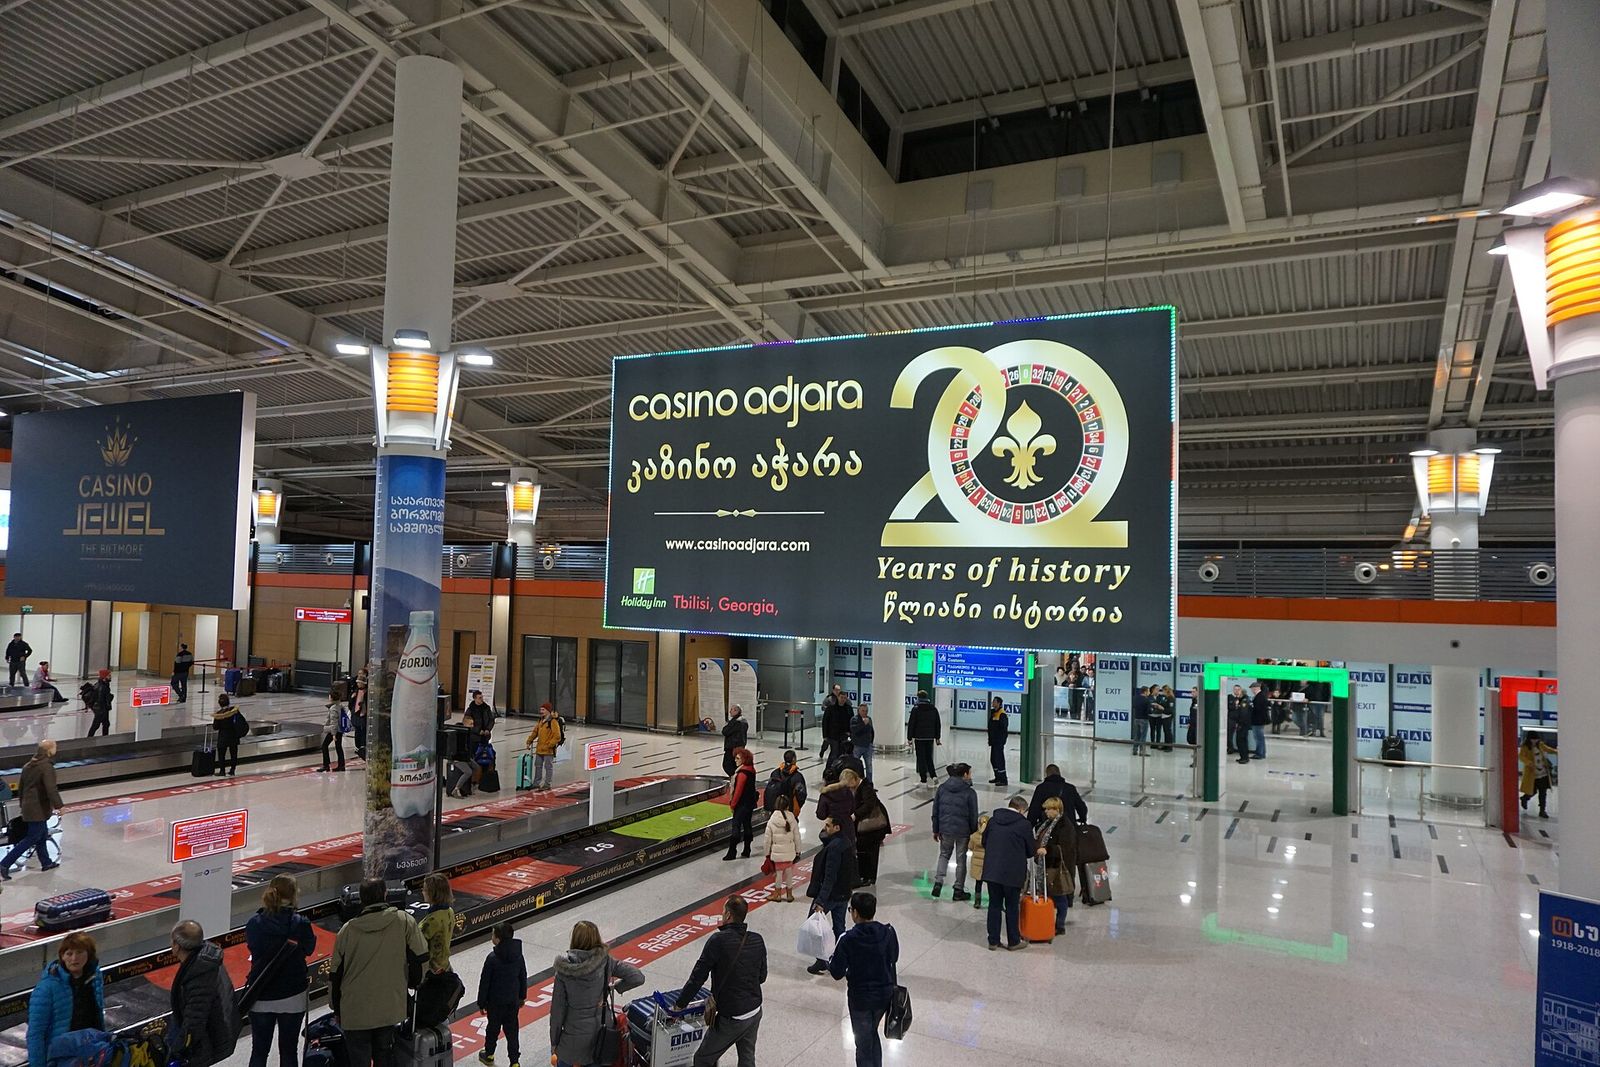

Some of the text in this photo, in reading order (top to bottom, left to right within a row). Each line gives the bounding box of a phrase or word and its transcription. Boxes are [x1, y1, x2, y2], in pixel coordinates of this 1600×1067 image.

[1008, 370, 1019, 381] 26
[1023, 368, 1029, 379] 0
[1032, 368, 1043, 380] 32
[1044, 370, 1054, 382] 15
[1064, 381, 1072, 392] 4
[629, 376, 863, 428] casino adjara
[970, 394, 981, 406] 28
[1080, 400, 1090, 408] 2
[1084, 408, 1096, 420] 25
[958, 415, 968, 426] 29
[1088, 422, 1098, 430] 17
[954, 438, 962, 448] 22
[627, 436, 862, 493] კაზინო აჭარა
[1086, 457, 1096, 468] 27
[1080, 469, 1092, 480] 13
[79, 472, 152, 497] CASINO
[964, 482, 976, 494] 20
[1066, 488, 1078, 500] 11
[980, 498, 992, 509] 33
[1048, 502, 1056, 513] 8
[1056, 496, 1068, 508] 30
[990, 503, 1000, 514] 16
[1036, 506, 1047, 518] 23
[63, 502, 165, 536] JEWEL
[1024, 510, 1034, 520] 10
[81, 544, 98, 554] THE
[665, 538, 810, 554] www.casinoadjara.com
[878, 556, 1131, 590] Years of history
[621, 596, 666, 609] Holiday Inn
[673, 594, 779, 616] Tbilisi, Georgia,
[883, 590, 1123, 629] წლიანი ისტორია
[1099, 660, 1130, 670] TAV
[1140, 661, 1172, 672] TAV
[1180, 663, 1204, 673] TA
[1350, 672, 1386, 682] TAV
[960, 700, 986, 710] TAV
[1098, 710, 1129, 721] TAV
[584, 842, 614, 854] 26
[570, 859, 635, 888] www.casinoiveria.com
[648, 926, 704, 952] MAGTI
[671, 1029, 703, 1046] TAV
